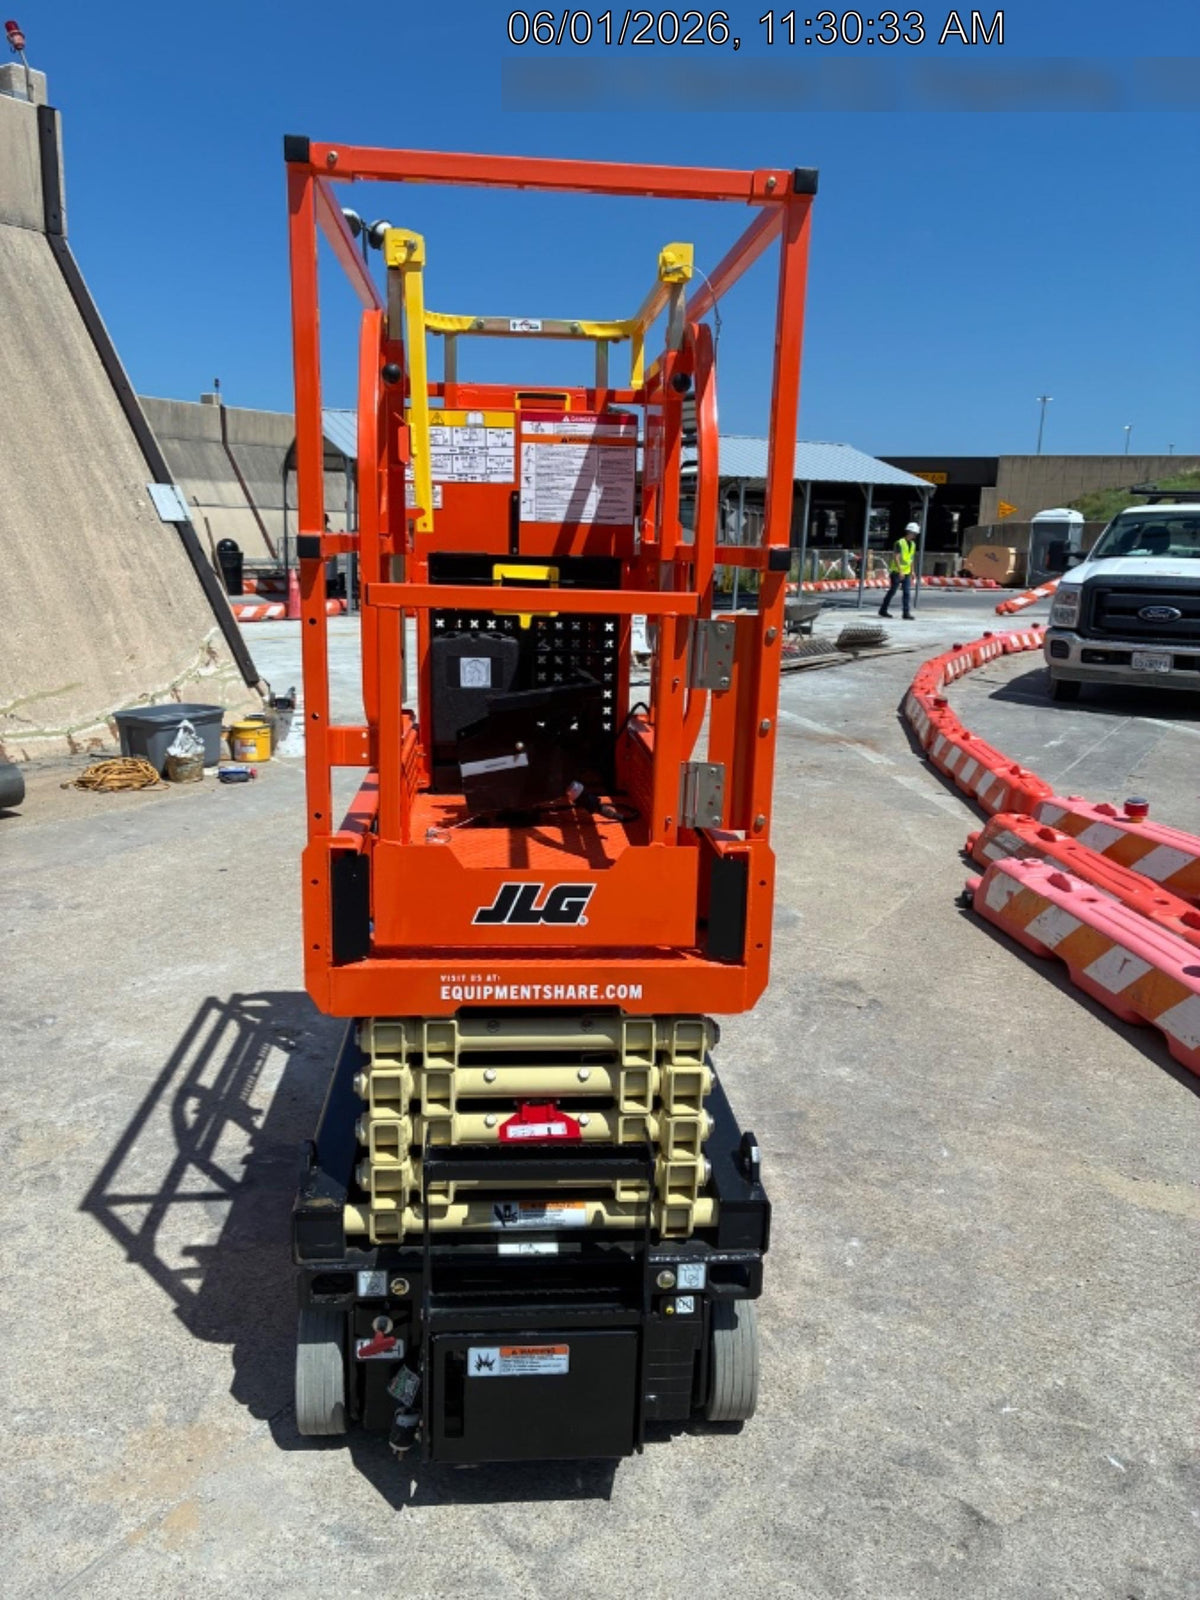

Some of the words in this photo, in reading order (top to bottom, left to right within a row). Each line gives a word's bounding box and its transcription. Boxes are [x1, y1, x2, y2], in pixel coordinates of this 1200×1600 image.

[470, 881, 598, 926] JLG
[440, 974, 466, 982] VISIT
[470, 974, 482, 982] US
[440, 984, 643, 1001] EQUIPMENTSHARE.COM
